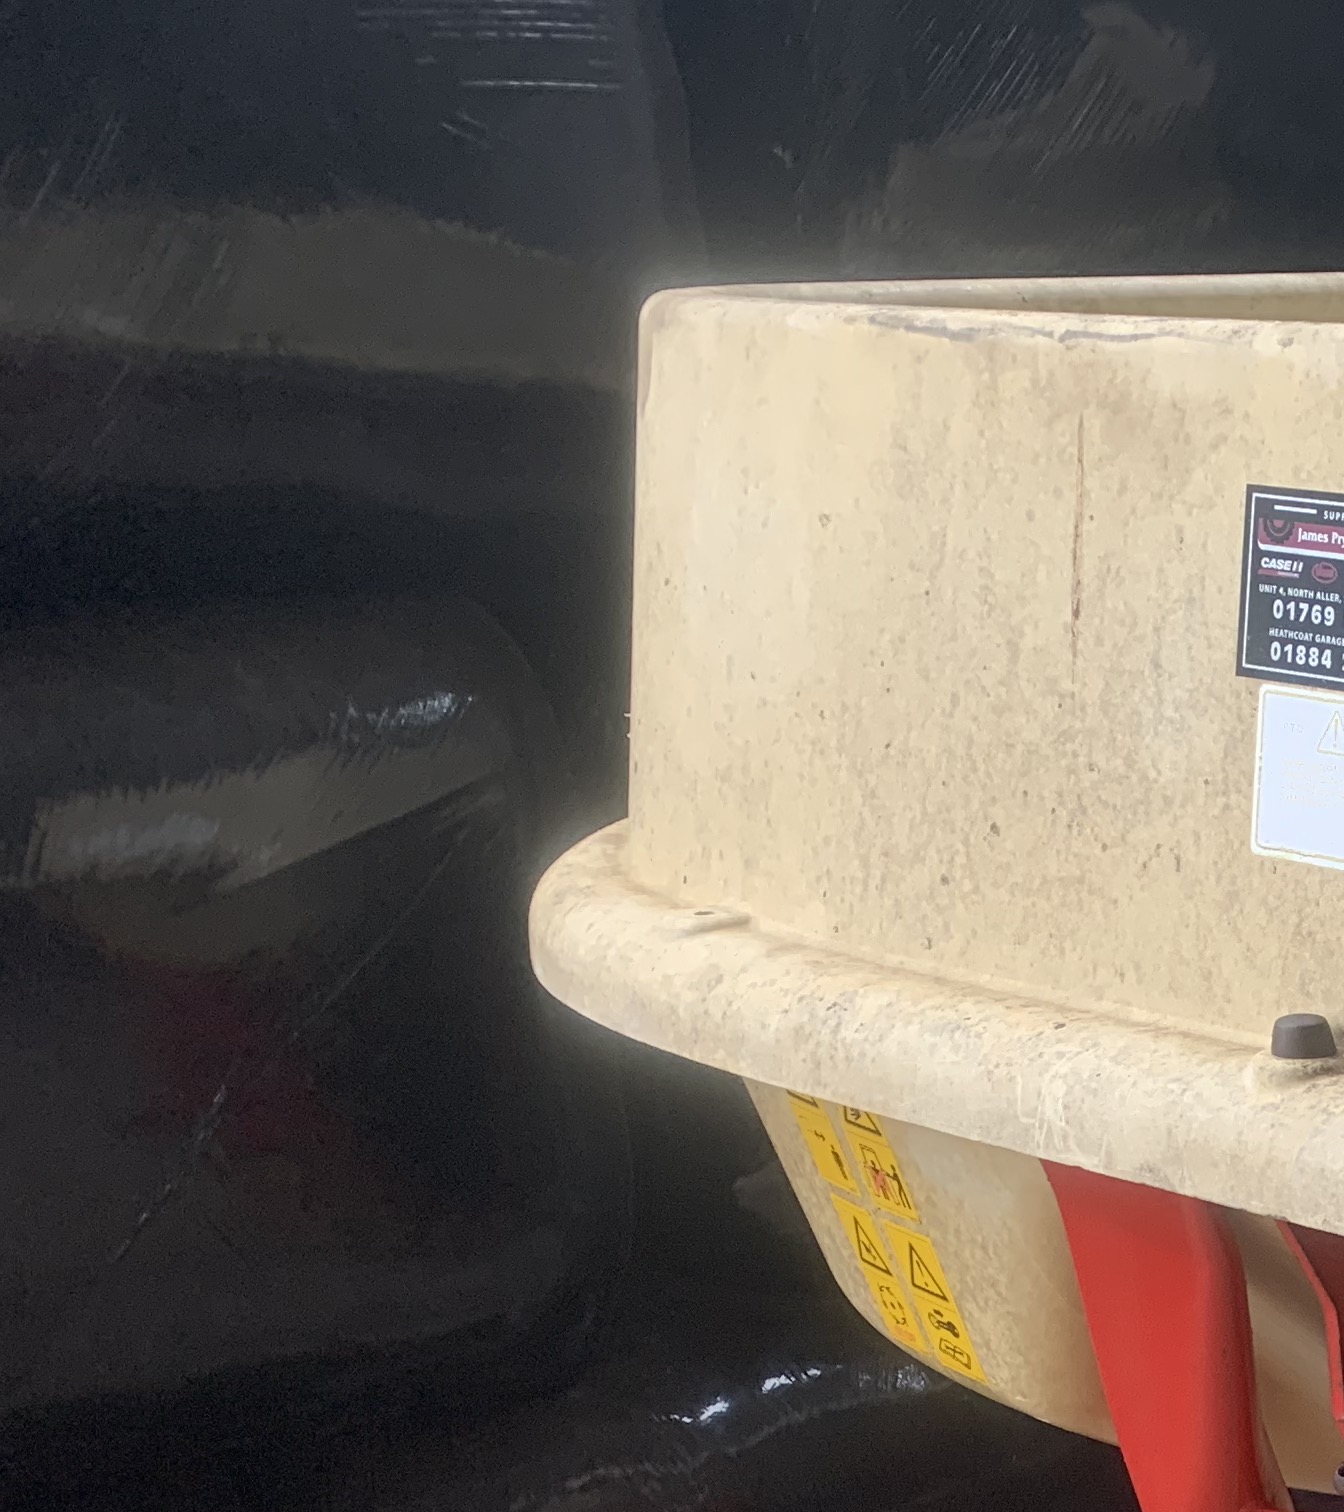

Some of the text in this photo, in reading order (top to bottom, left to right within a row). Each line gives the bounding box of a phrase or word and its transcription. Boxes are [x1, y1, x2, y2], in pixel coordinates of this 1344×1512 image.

[1297, 527, 1328, 546] James
[1261, 557, 1292, 571] CASE
[1259, 584, 1277, 594] UNIT
[1279, 587, 1286, 596] 4,
[1287, 588, 1314, 599] NORTH
[1316, 591, 1341, 604] ALLER,
[1273, 599, 1335, 627] 01769
[1269, 628, 1313, 642] HEATHCOAT
[1270, 641, 1332, 669] 01884
